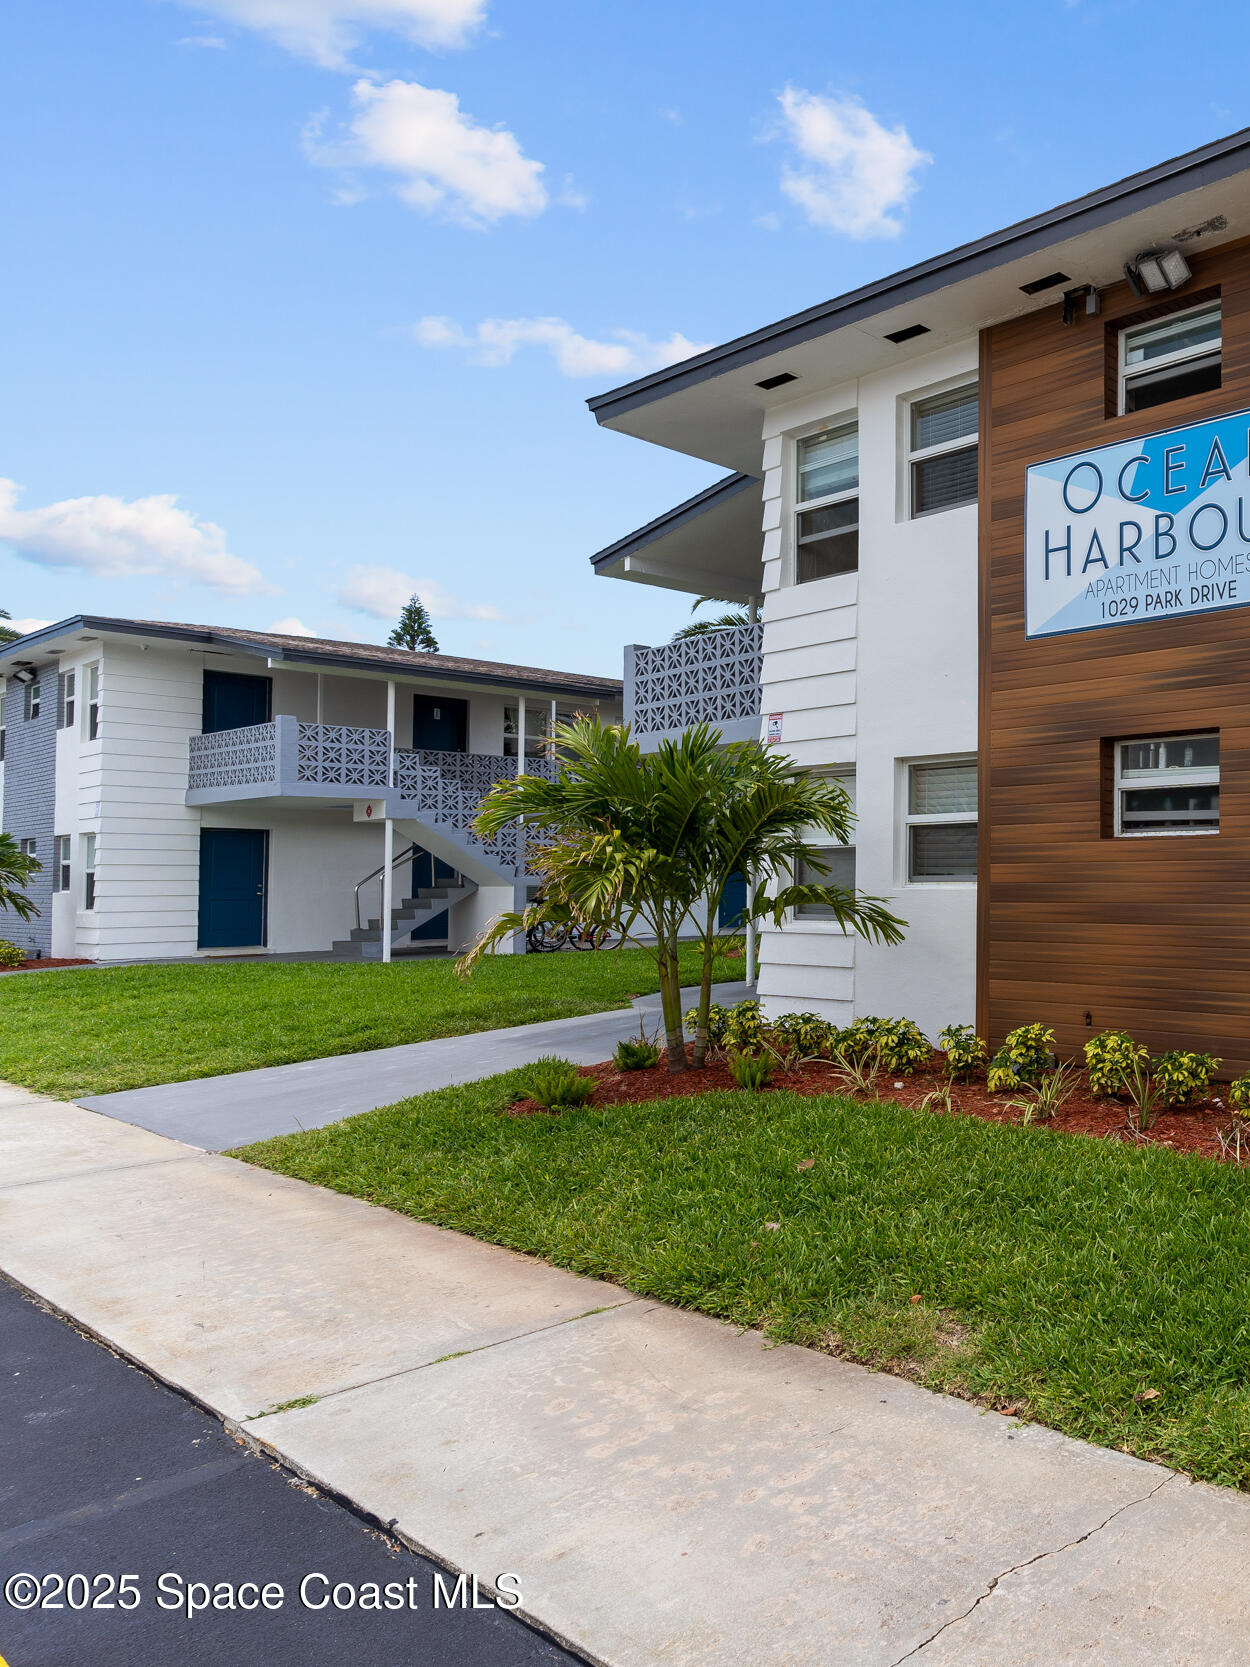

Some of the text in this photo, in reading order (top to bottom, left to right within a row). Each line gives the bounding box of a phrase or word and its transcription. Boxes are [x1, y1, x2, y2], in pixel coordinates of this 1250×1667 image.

[1084, 565, 1181, 600] APARTMENT
[1100, 579, 1237, 618] 1029 PARK DRIVE
